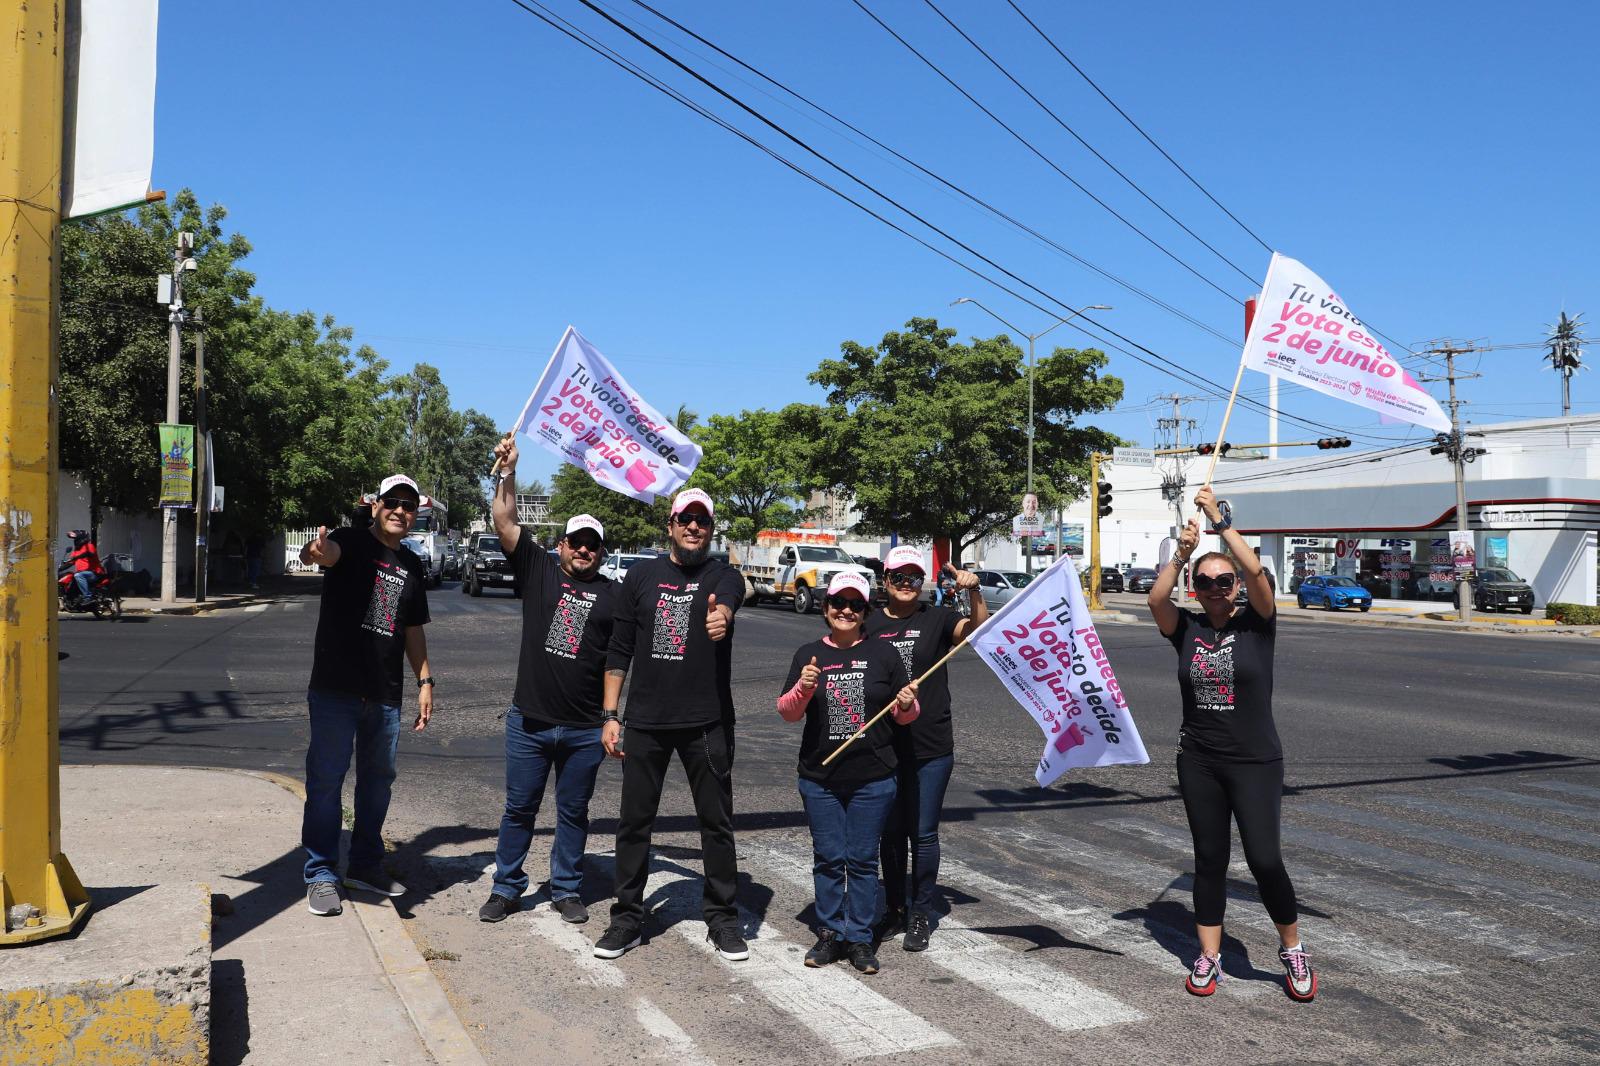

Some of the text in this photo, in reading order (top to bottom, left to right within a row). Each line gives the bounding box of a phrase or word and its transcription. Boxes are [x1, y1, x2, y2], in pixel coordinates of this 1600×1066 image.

[1288, 283, 1361, 326] Tu voto
[1280, 302, 1393, 361] Vota est
[1262, 323, 1287, 343] 2
[1286, 330, 1323, 354] de
[1316, 340, 1396, 378] junio
[1278, 353, 1297, 365] iees
[1298, 371, 1319, 381] Sinaloa
[559, 378, 603, 423] Vota
[602, 419, 641, 454] este
[571, 363, 680, 465] Tu voto decide
[541, 396, 562, 417] 2
[559, 412, 586, 435] de
[576, 426, 625, 469] junio
[549, 426, 563, 439] iees
[1335, 539, 1362, 558] 0%
[1380, 538, 1411, 547] HS
[377, 570, 385, 578] TU
[385, 573, 405, 586] VOTO
[562, 593, 593, 608] TU VOTO
[660, 593, 694, 603] TU VOTO
[892, 640, 915, 648] VOTO
[1029, 610, 1071, 669] Vota
[1002, 624, 1029, 644] 2
[1018, 645, 1048, 671] de
[1196, 646, 1233, 657] TU VOTO
[1003, 653, 1018, 670] iees
[1190, 660, 1234, 670] DECIDE
[840, 672, 865, 681] VOTO
[1049, 597, 1071, 625] Tu
[1080, 681, 1121, 744] decide
[826, 680, 864, 689] DECIDE
[1194, 685, 1234, 694] DECIDE
[826, 688, 865, 698] DECIDE
[1196, 694, 1236, 704] DECIDE
[827, 696, 865, 706] DECIDE
[828, 705, 865, 715] DECIDE
[829, 714, 865, 724] DECIDE
